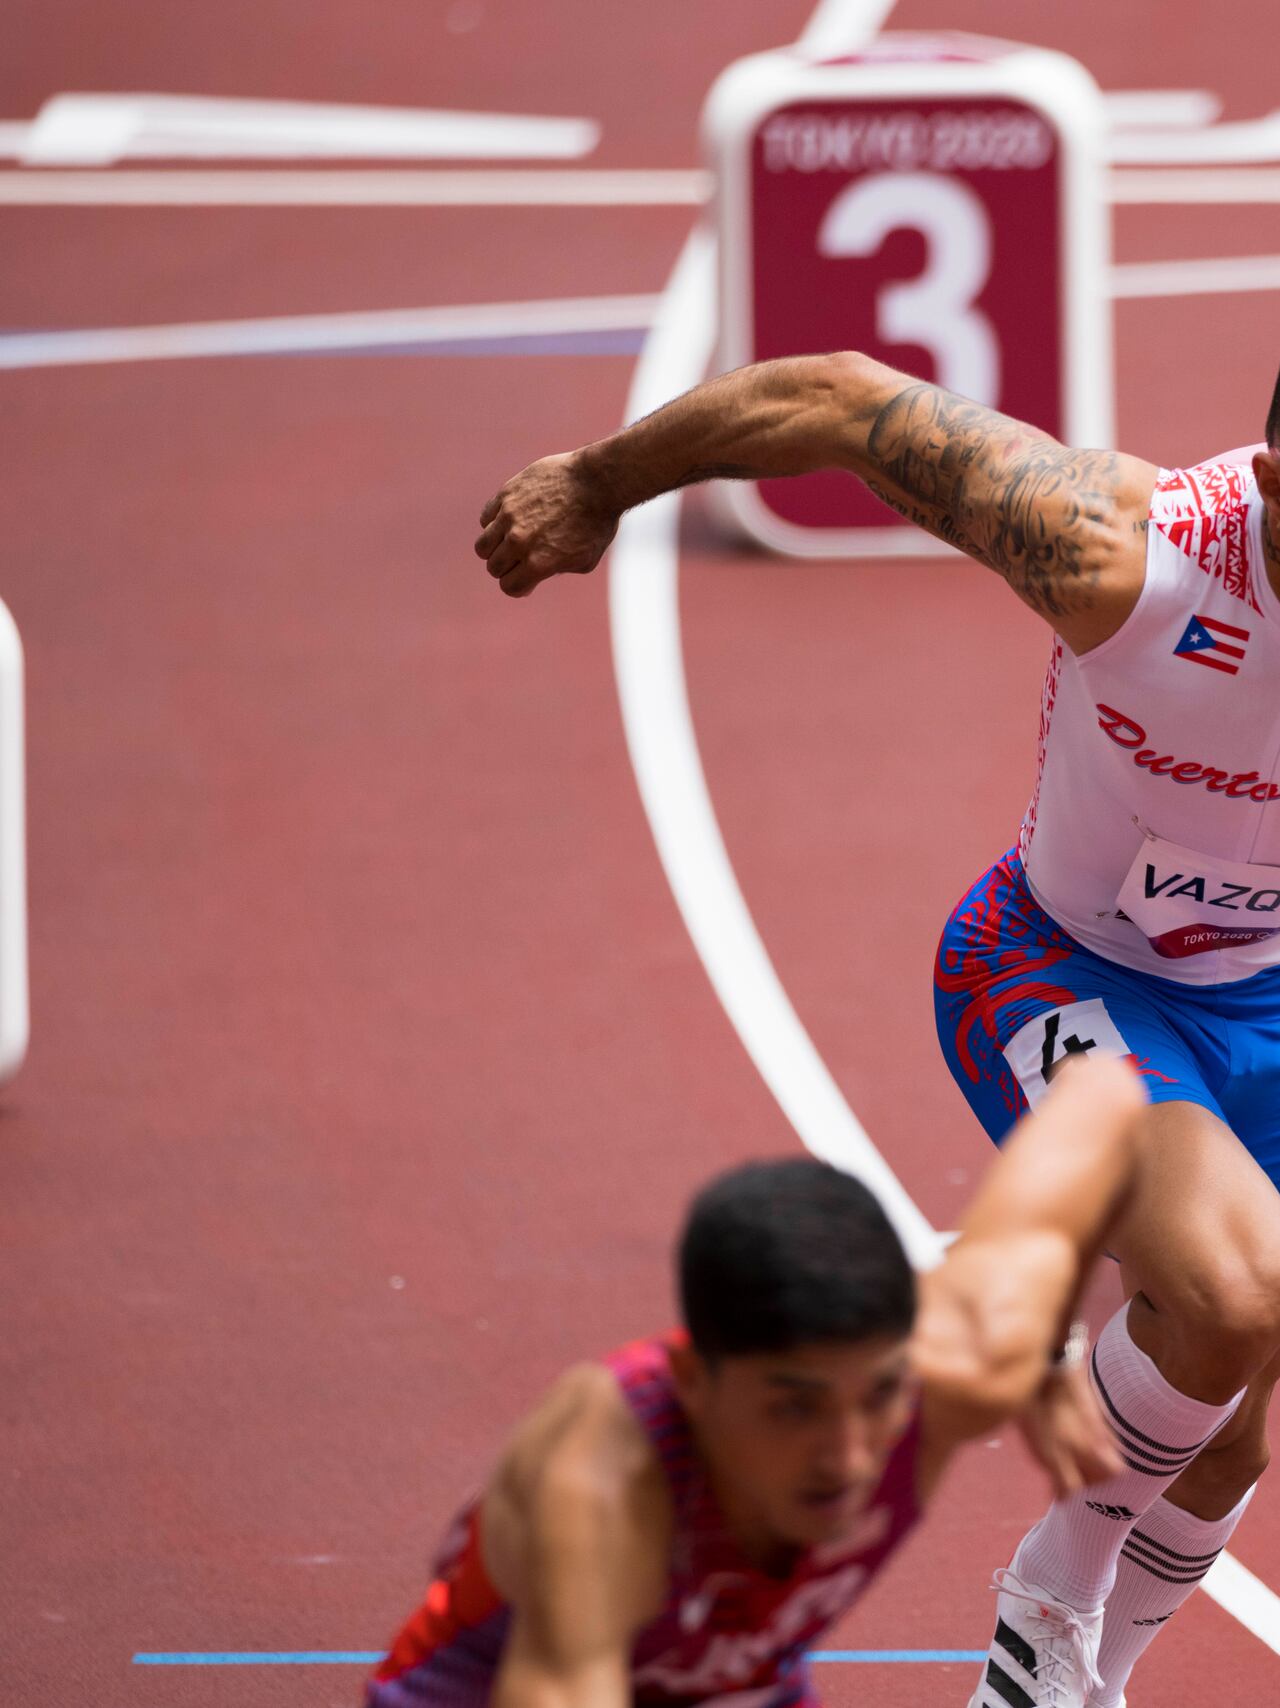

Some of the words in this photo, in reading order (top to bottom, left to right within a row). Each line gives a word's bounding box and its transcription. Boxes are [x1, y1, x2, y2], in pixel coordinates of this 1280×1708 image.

[818, 174, 998, 412] 3
[1183, 932, 1220, 947] TOKYO
[1221, 932, 1253, 940] 2020
[1040, 1012, 1097, 1086] 4
